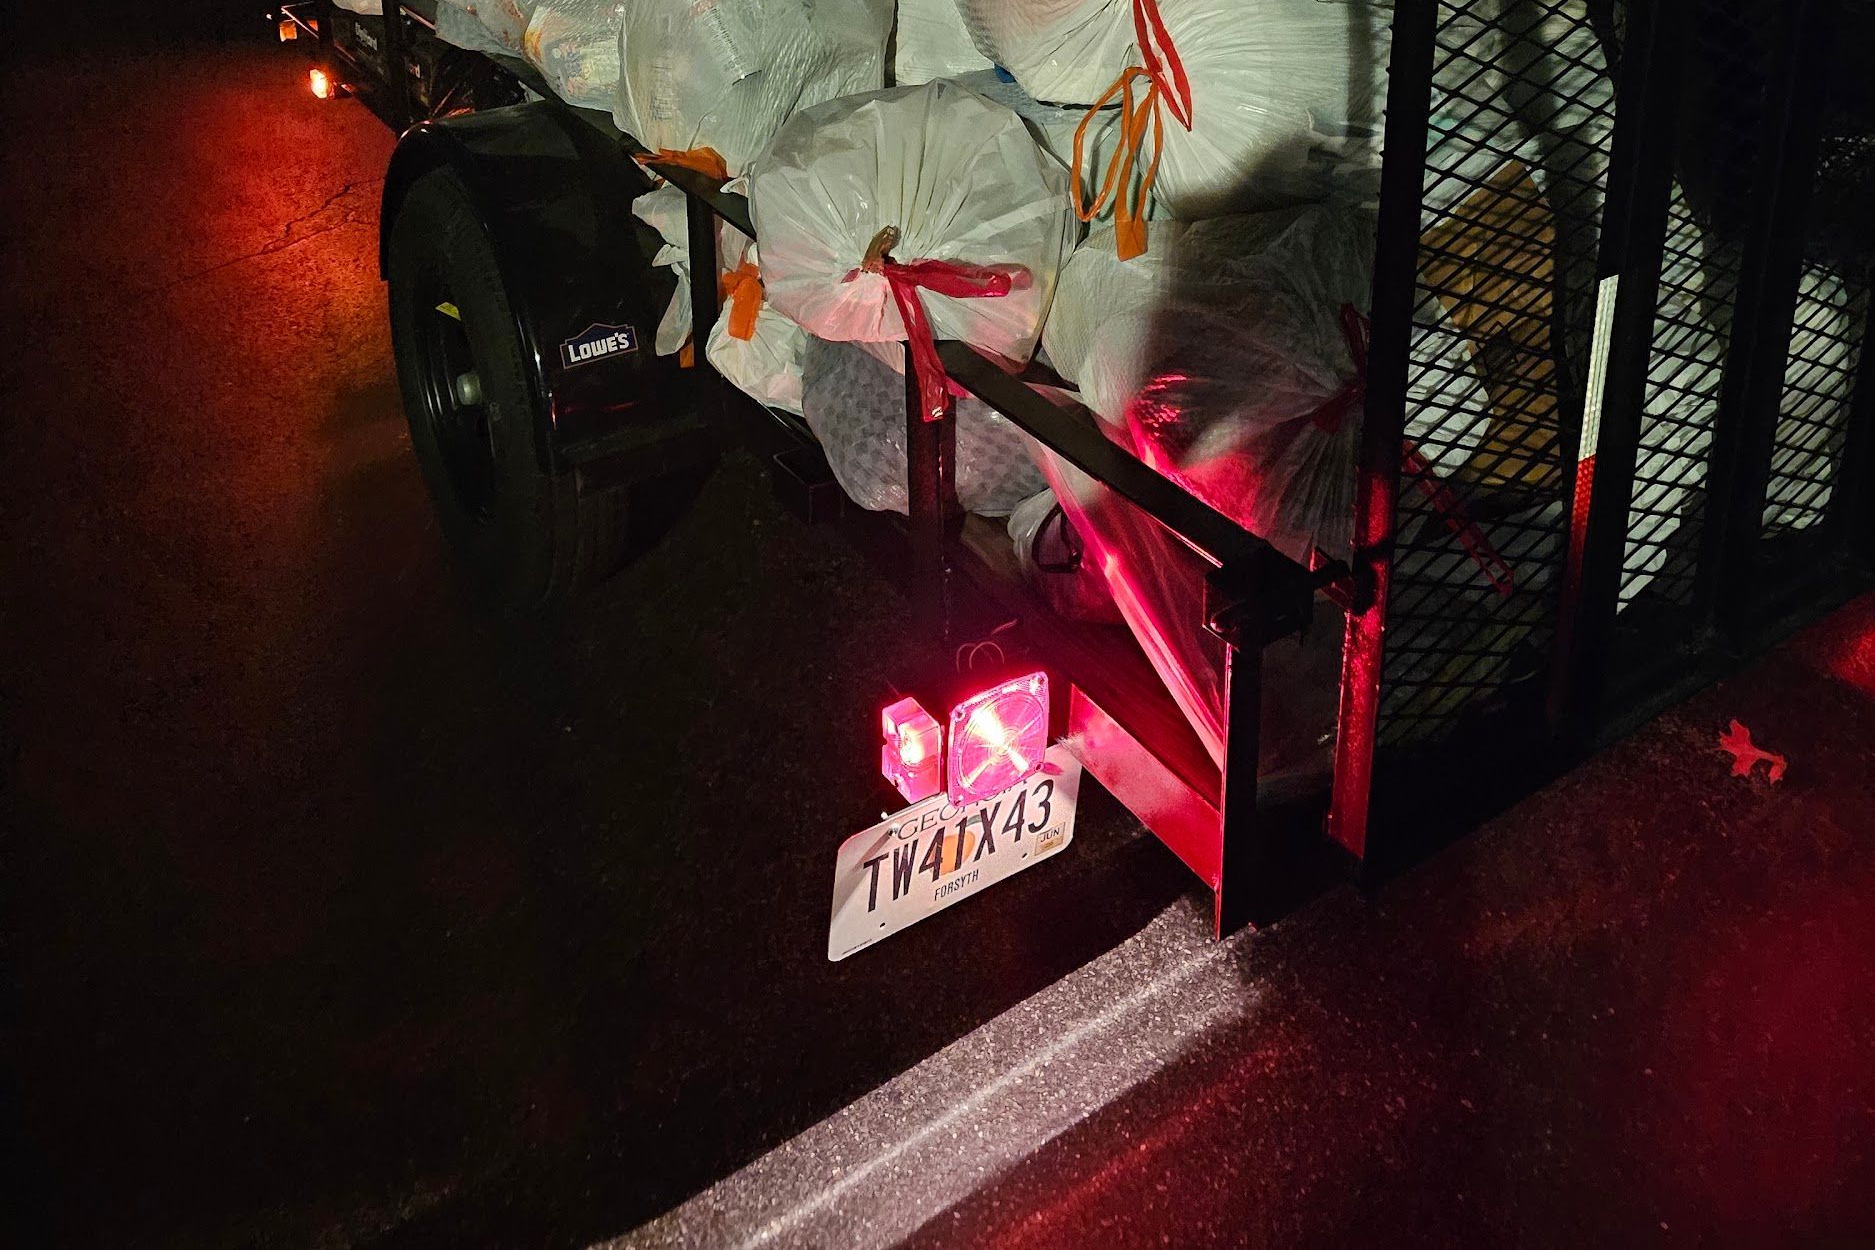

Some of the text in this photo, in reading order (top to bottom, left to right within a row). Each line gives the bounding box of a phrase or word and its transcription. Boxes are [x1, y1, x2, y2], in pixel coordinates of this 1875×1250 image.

[568, 332, 629, 362] LOWE'S
[863, 779, 1054, 912] TW41X43
[1040, 827, 1060, 842] JUN
[934, 869, 979, 901] FORSYTH
